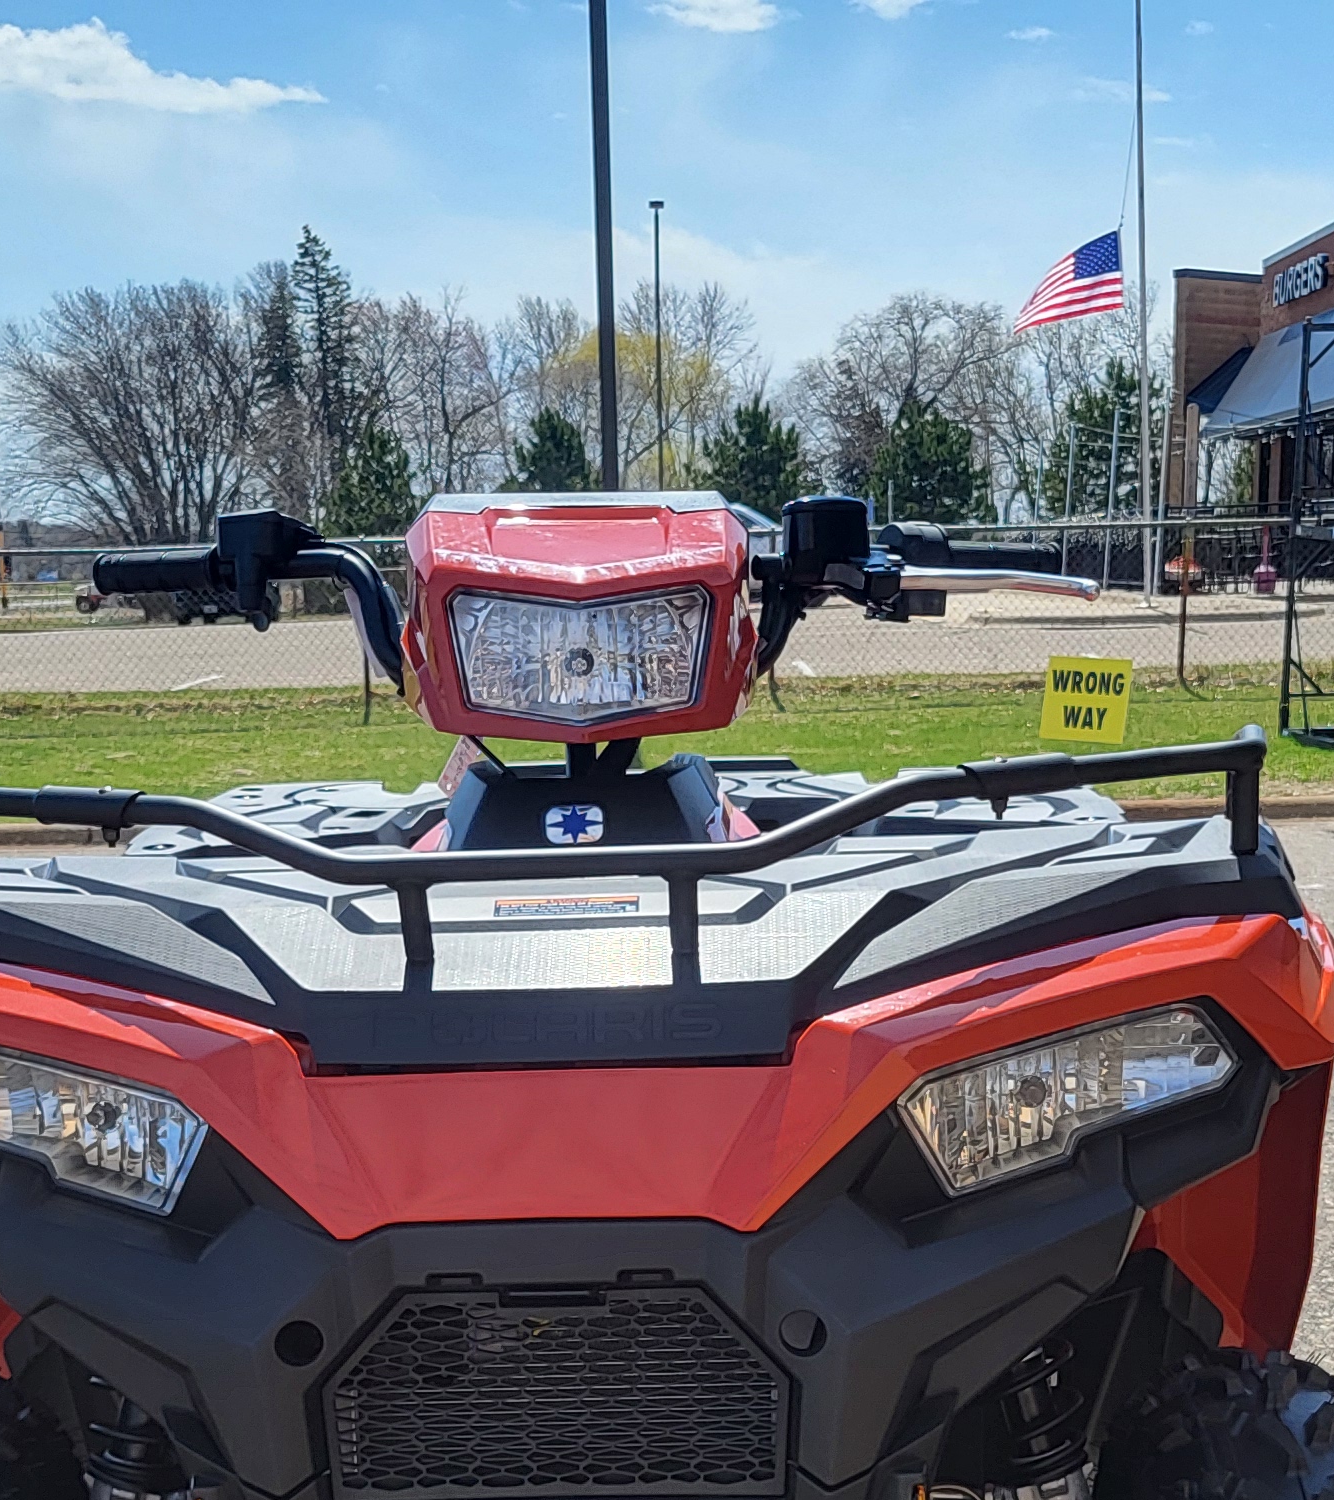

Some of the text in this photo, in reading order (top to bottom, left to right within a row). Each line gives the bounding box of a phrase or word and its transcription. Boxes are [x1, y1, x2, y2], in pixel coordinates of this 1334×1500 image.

[1271, 254, 1327, 307] BURGERS
[1051, 669, 1126, 697] WRONG
[1062, 705, 1109, 731] WAY
[371, 1002, 723, 1048] POLARIS
